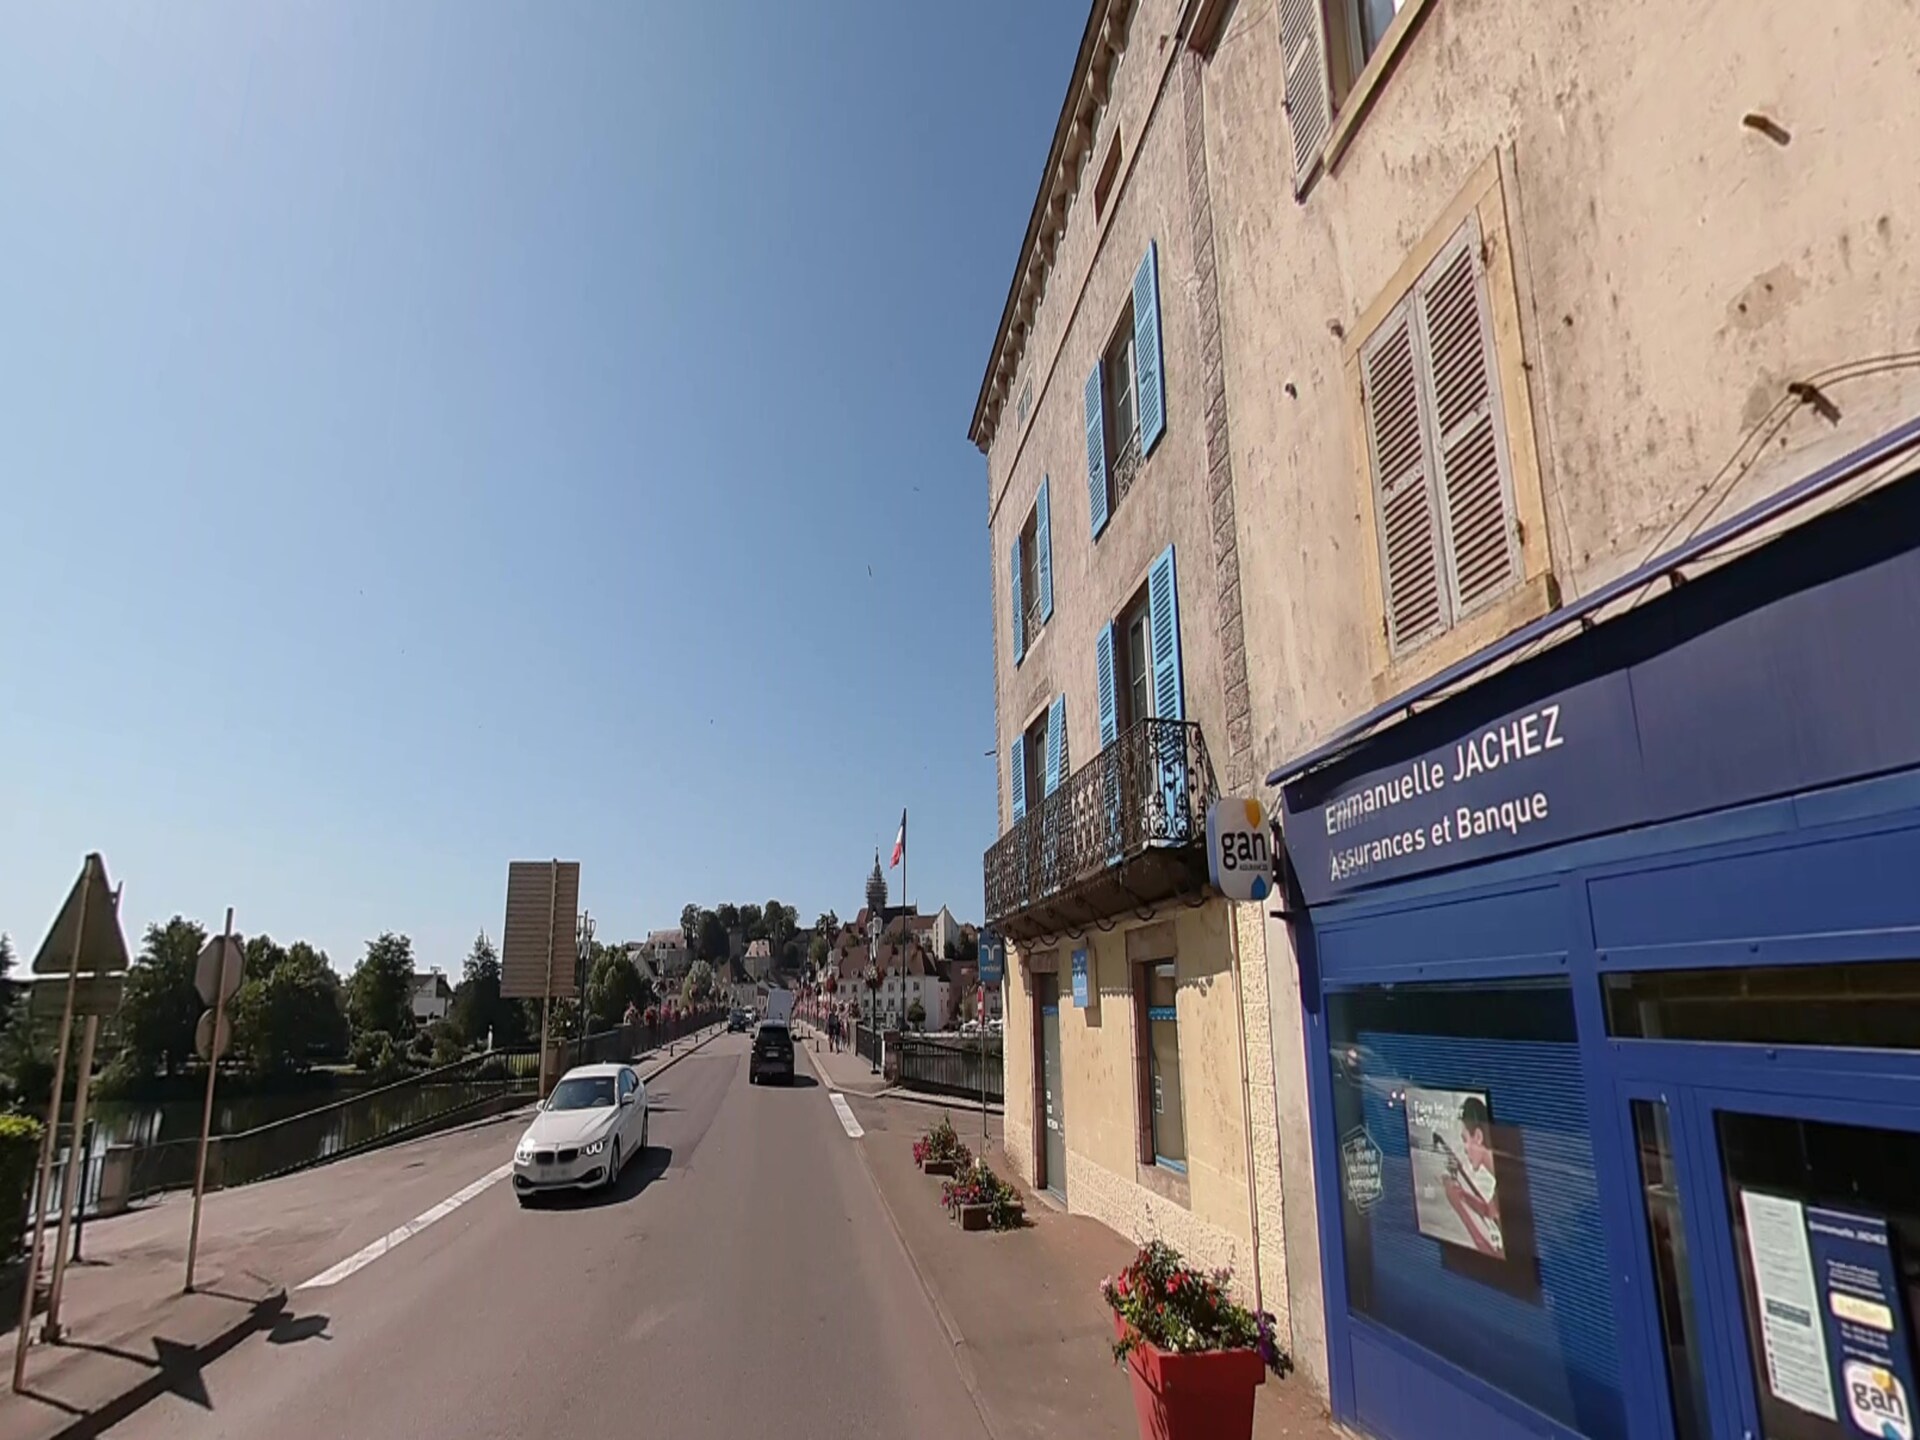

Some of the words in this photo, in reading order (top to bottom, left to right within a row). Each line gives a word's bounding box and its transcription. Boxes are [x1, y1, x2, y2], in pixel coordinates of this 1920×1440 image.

[1325, 759, 1445, 836] Emmanuelle
[1452, 704, 1564, 782] JACHEZ
[1221, 831, 1267, 870] gan
[1329, 827, 1426, 882] Assurances
[1430, 815, 1453, 846] et
[1456, 792, 1548, 840] Banque
[1852, 1382, 1904, 1418] gan
